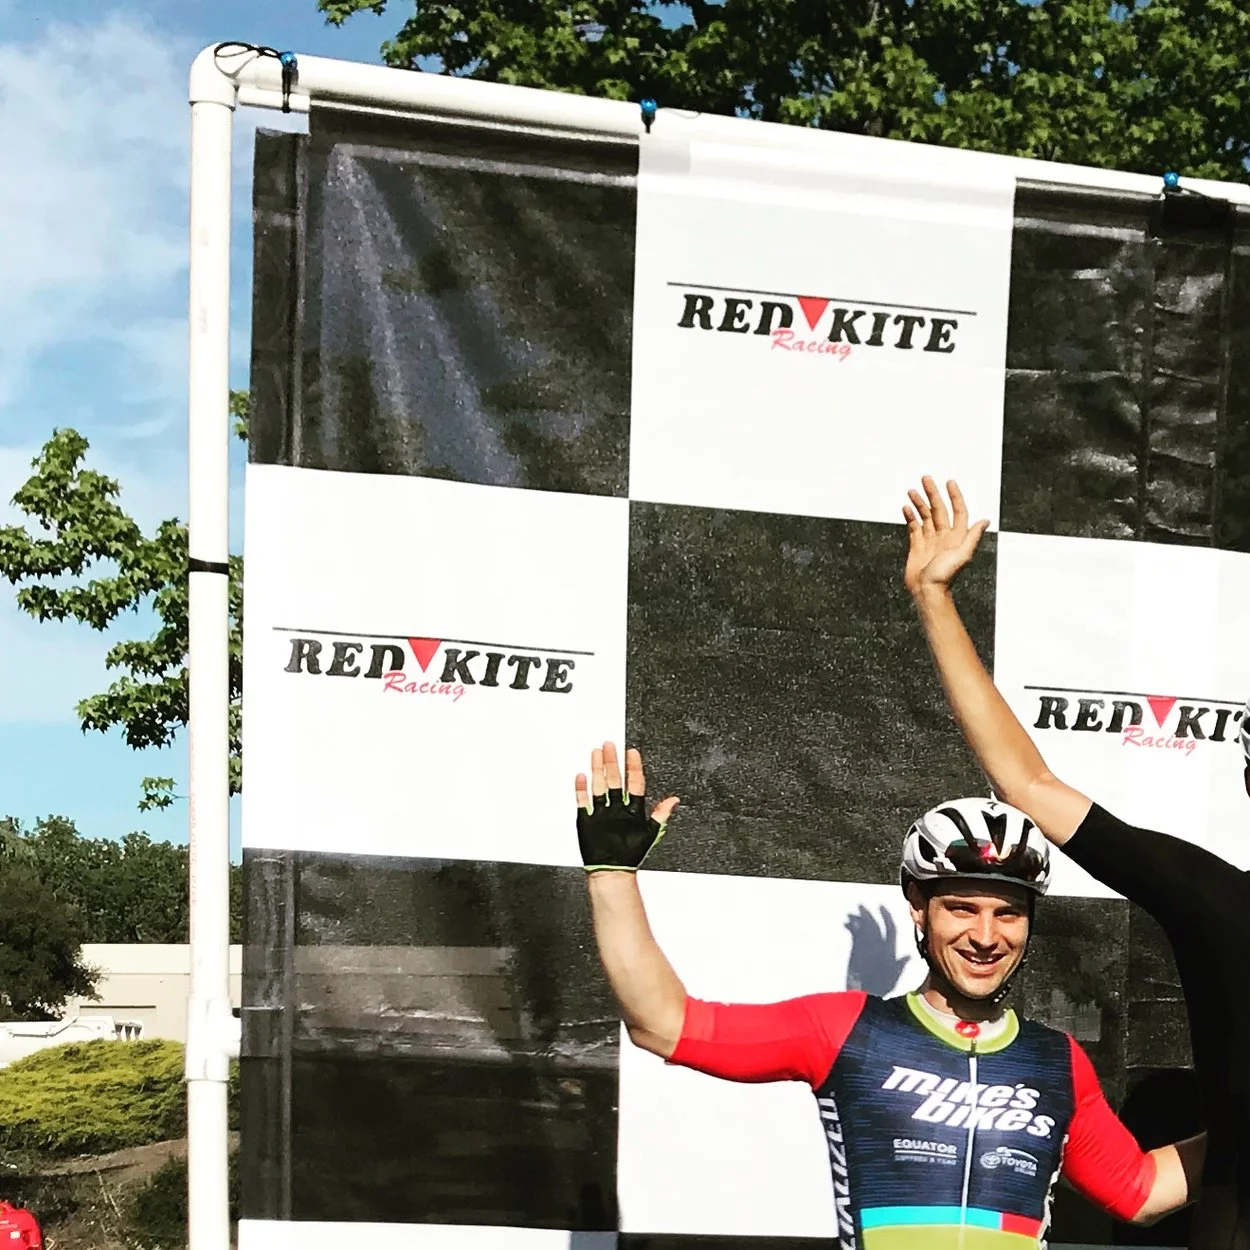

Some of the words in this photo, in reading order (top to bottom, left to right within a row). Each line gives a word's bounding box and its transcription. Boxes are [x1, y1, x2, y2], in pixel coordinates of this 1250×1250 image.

[677, 294, 793, 335] RED
[827, 308, 958, 353] KITE
[771, 328, 853, 362] Racing
[284, 639, 405, 678] RED
[440, 648, 575, 693] KITE
[383, 669, 466, 701] Racing
[1033, 696, 1143, 733] RED
[1122, 727, 1198, 756] Racing
[893, 1138, 957, 1155] EQUATOR
[1001, 1155, 1038, 1171] TOYOTA
